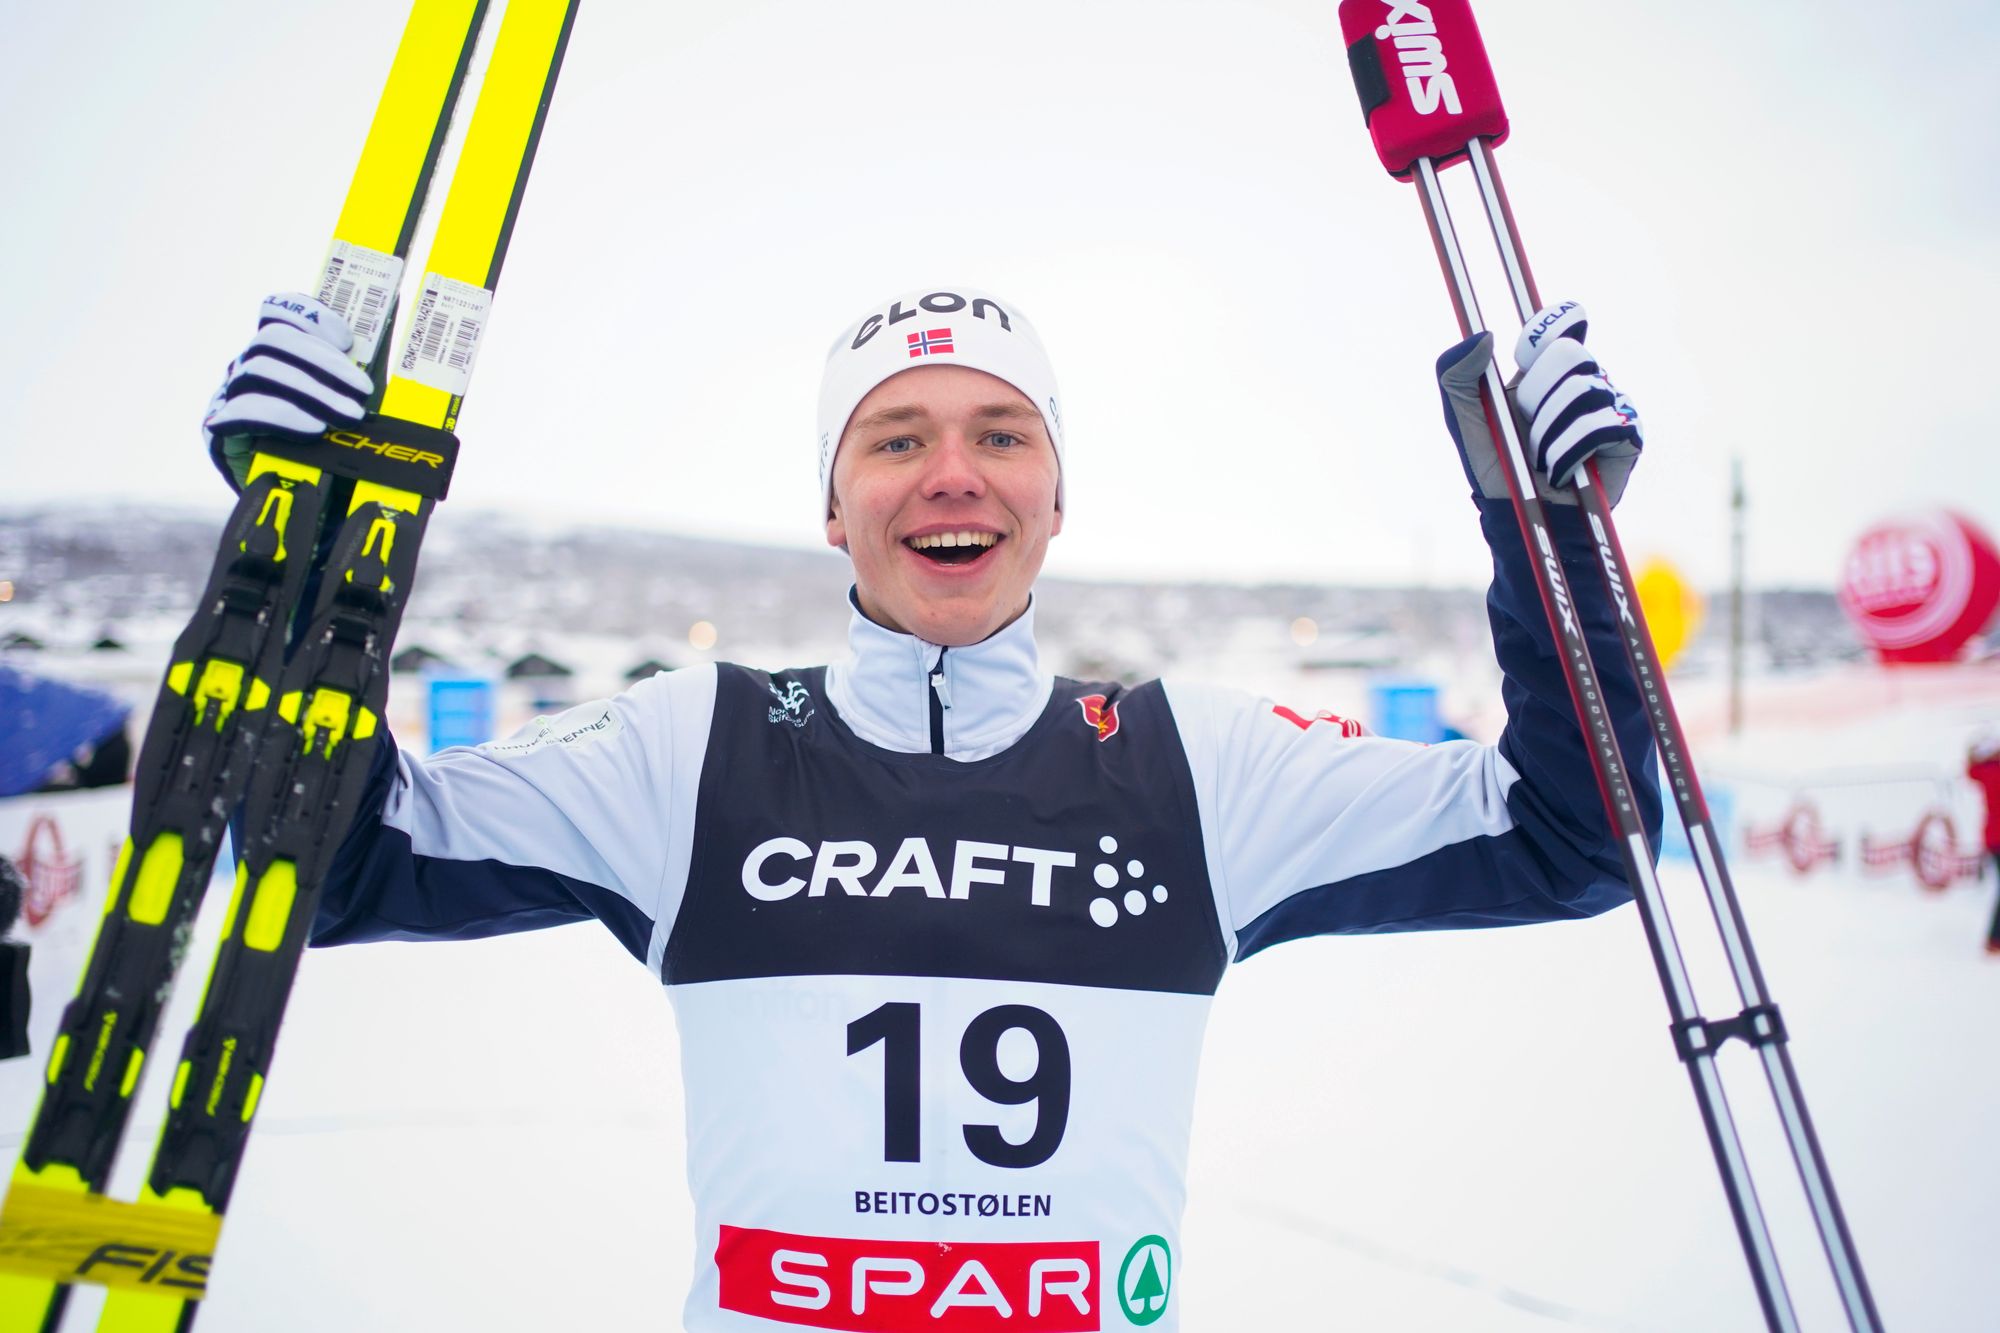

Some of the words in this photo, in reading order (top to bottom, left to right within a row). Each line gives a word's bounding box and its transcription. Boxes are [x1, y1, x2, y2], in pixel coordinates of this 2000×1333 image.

[323, 431, 444, 468] CHER
[742, 837, 1077, 907] CRAFT
[847, 1001, 1072, 1169] 19
[855, 1191, 1052, 1217] BEITOSTØLEN
[770, 1248, 1092, 1319] SPAR
